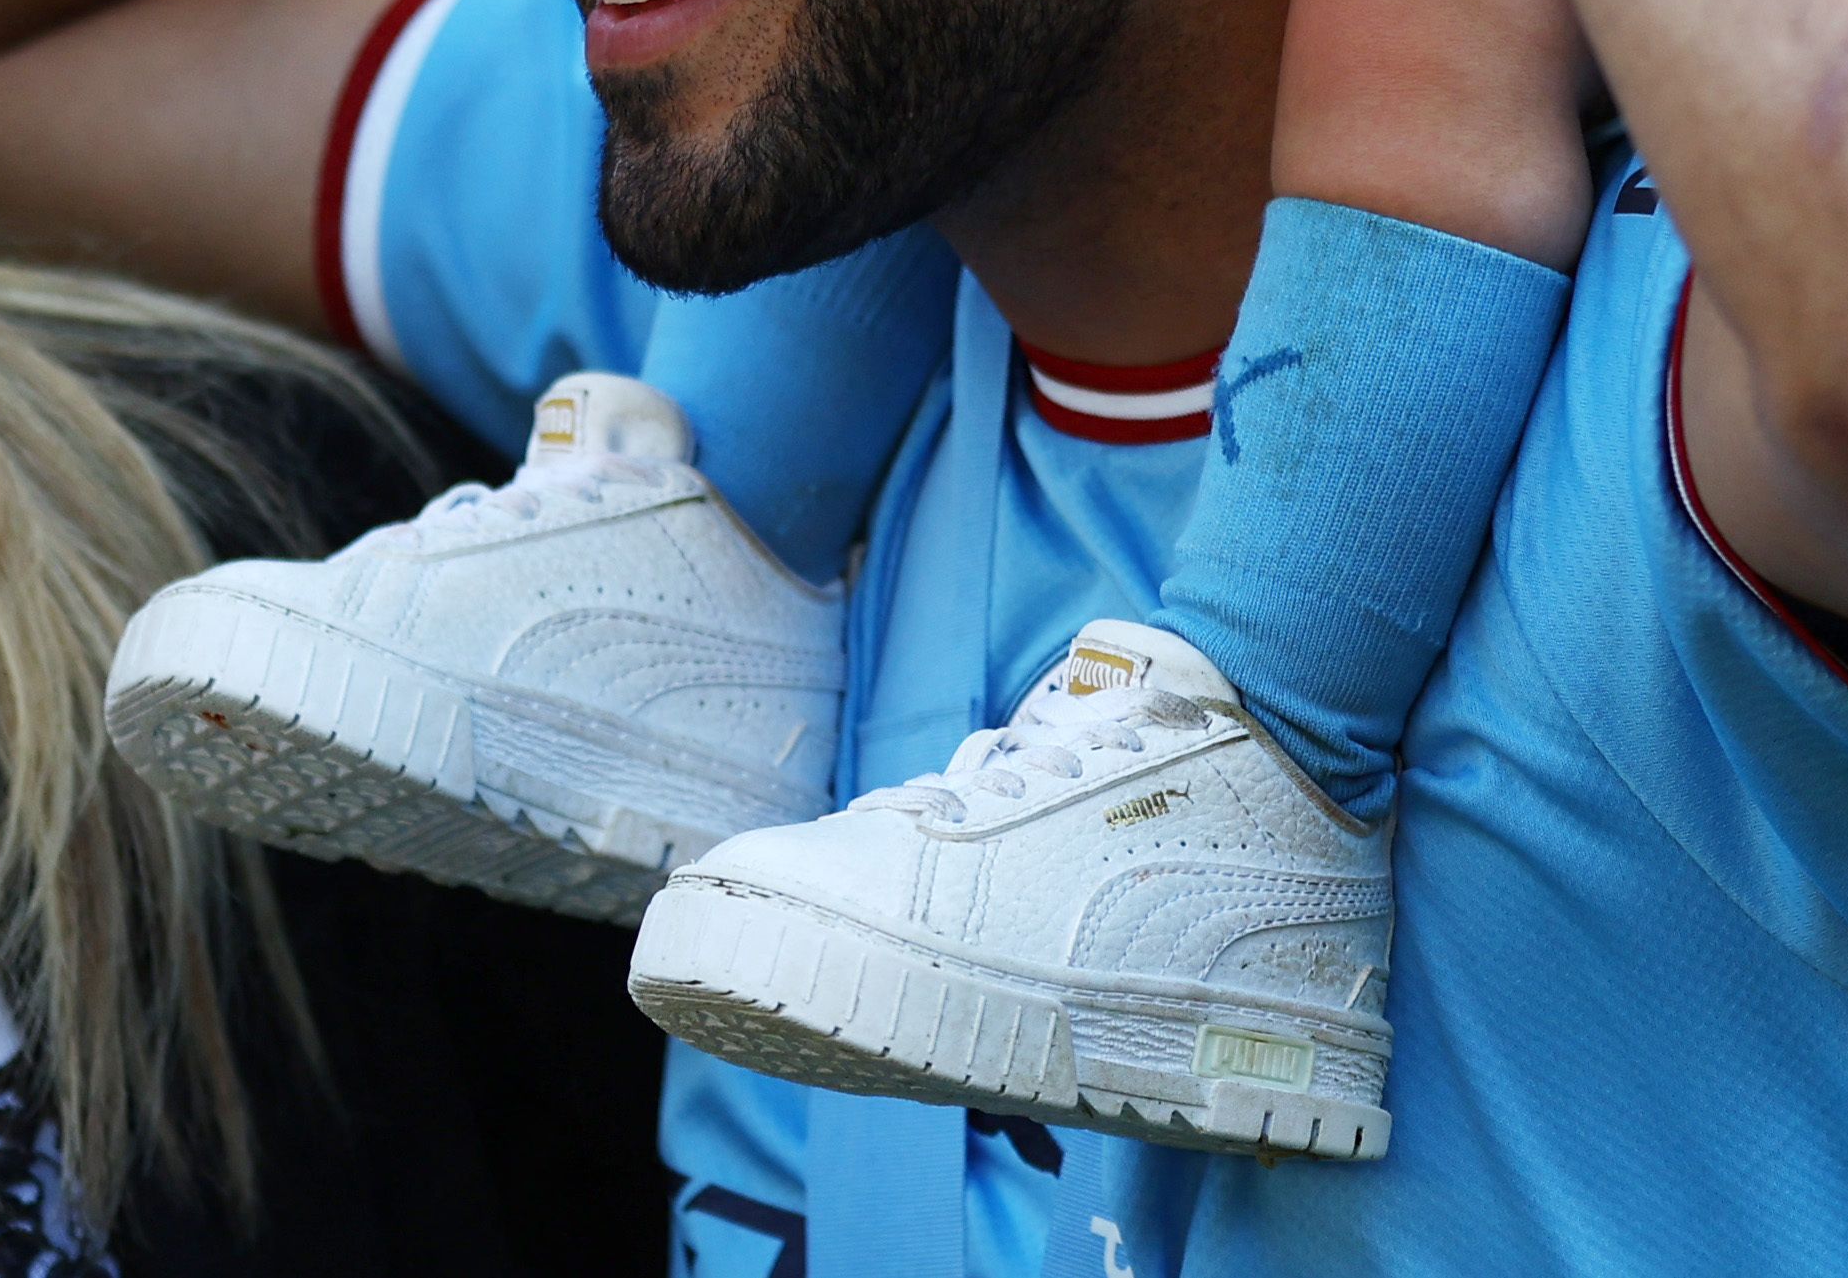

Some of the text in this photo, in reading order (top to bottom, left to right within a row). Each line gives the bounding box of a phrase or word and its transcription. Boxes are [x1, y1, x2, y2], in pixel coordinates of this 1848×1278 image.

[1069, 655, 1129, 689] PUMA
[1103, 790, 1170, 831] PUMA
[1211, 1035, 1301, 1083] PUMA
